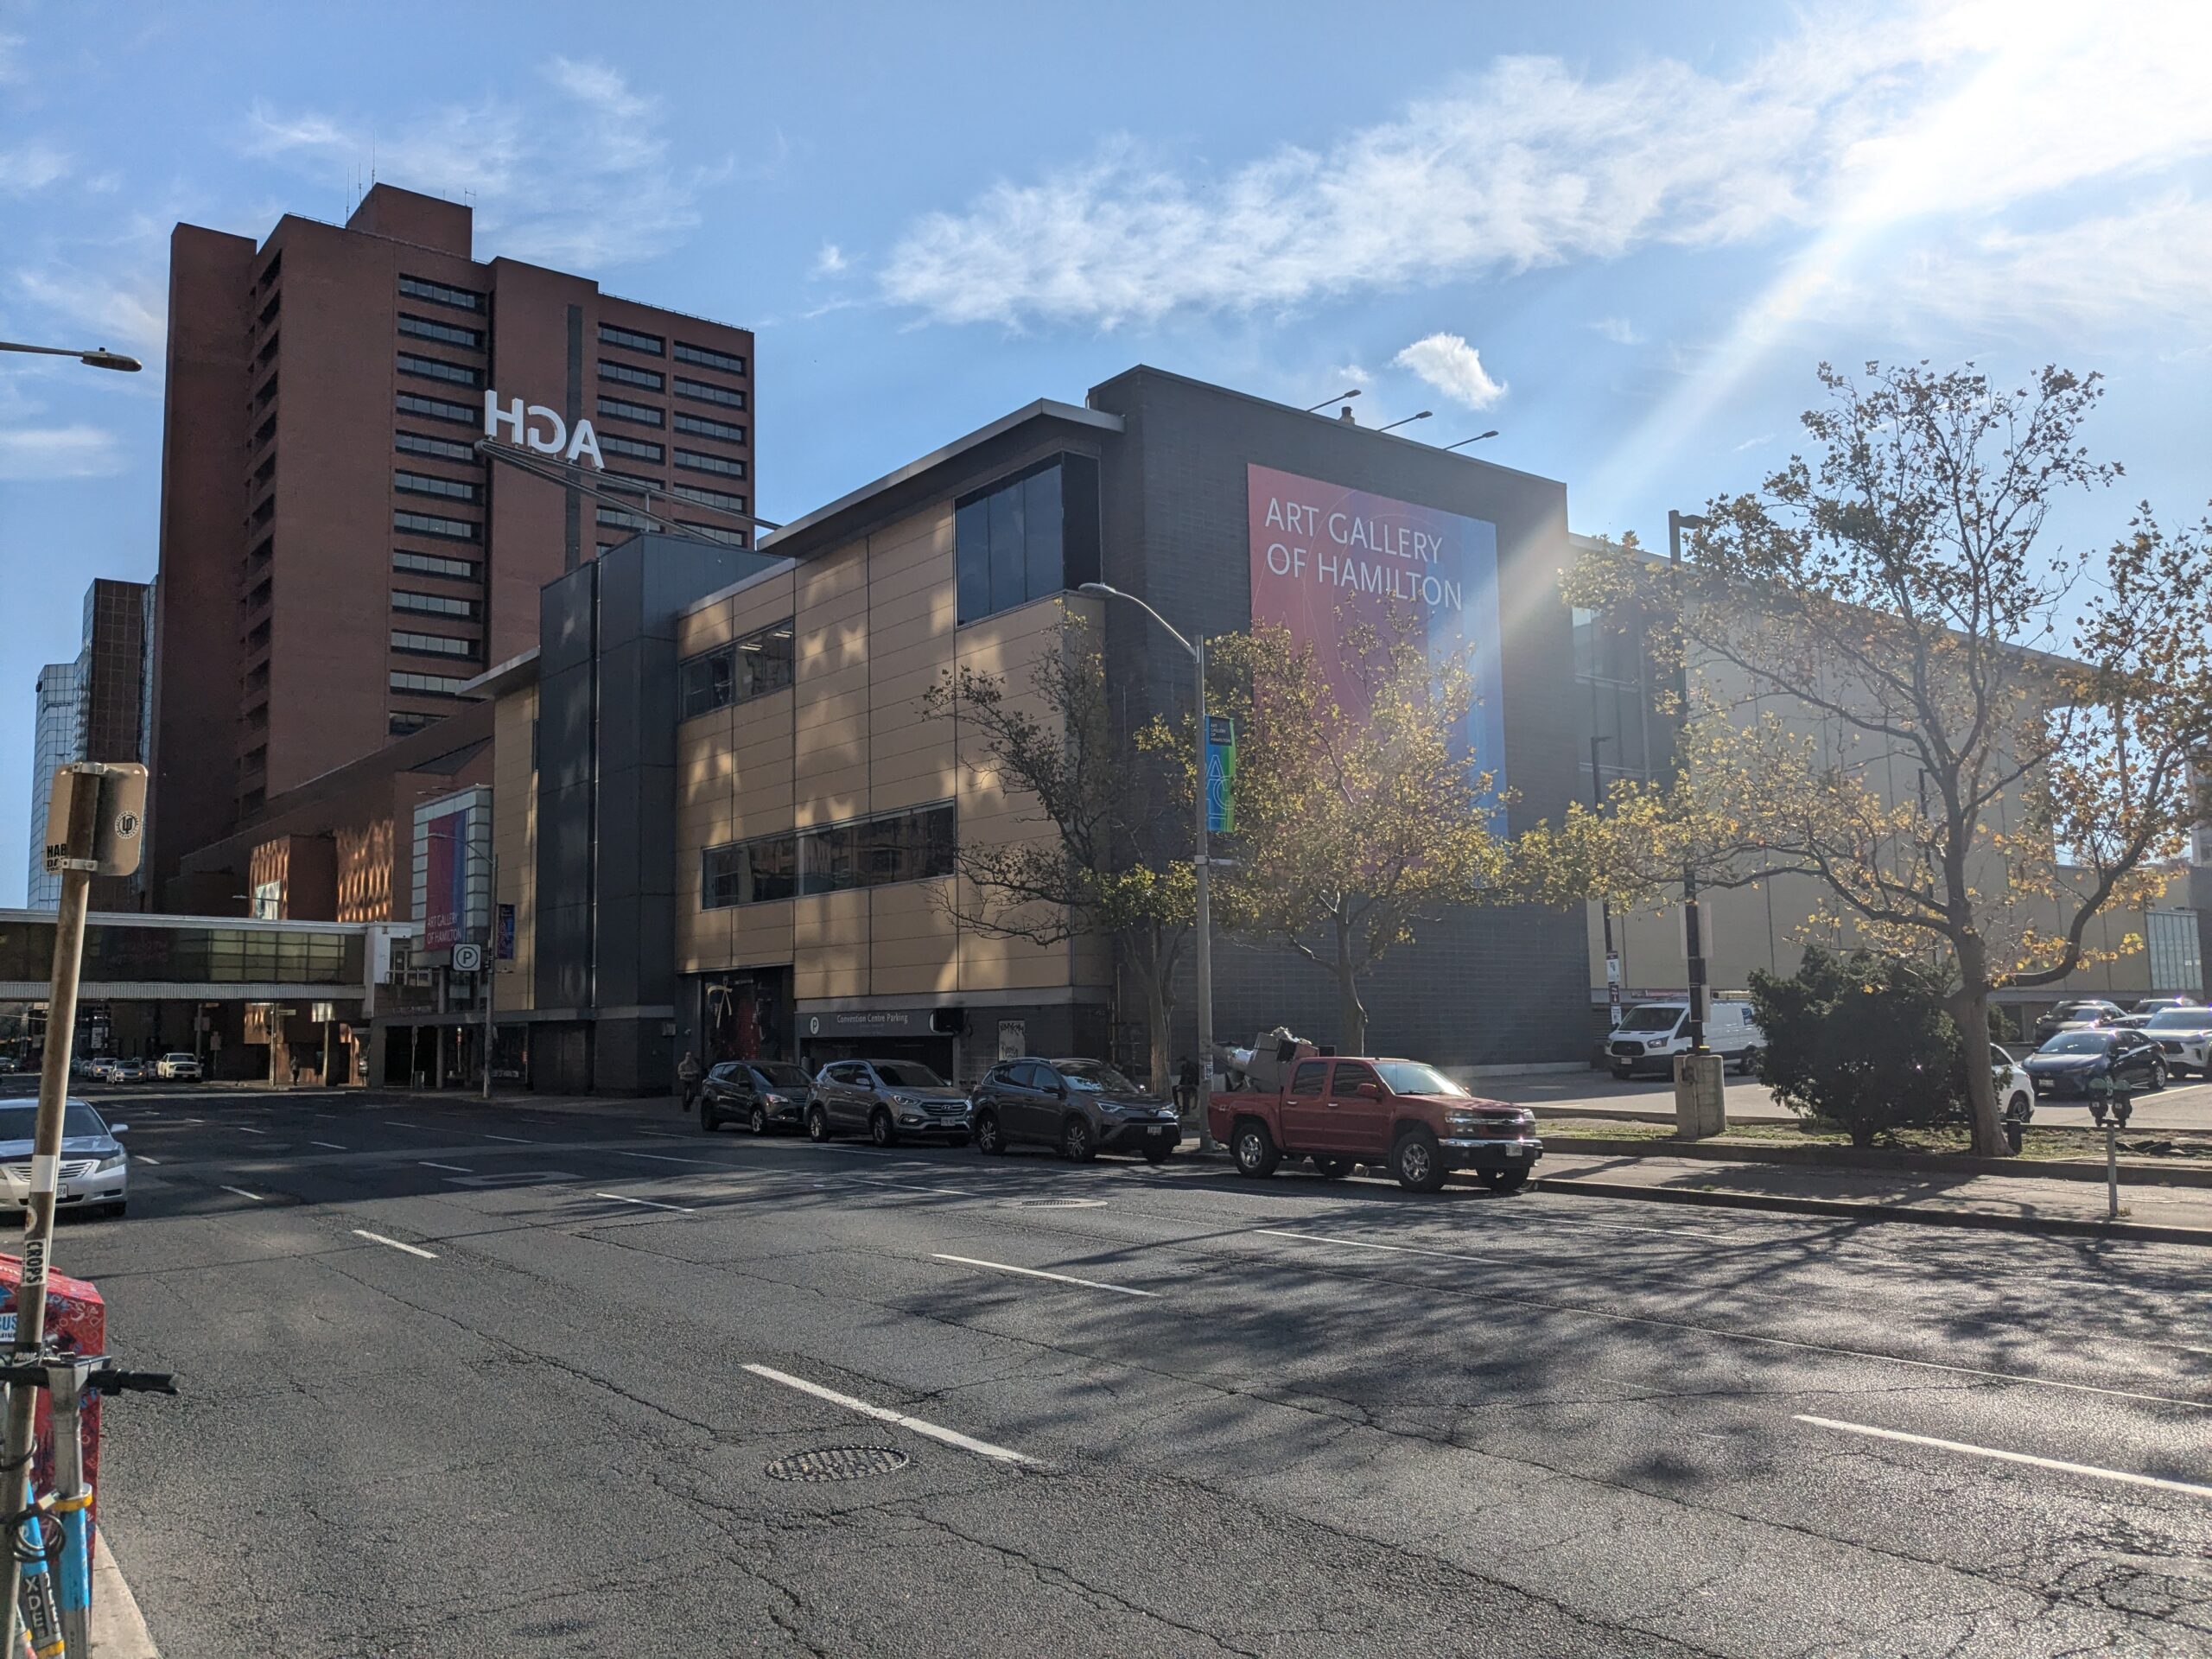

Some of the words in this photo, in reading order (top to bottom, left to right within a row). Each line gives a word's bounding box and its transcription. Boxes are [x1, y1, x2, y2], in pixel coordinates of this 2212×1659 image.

[1266, 497, 1319, 537] ART
[1328, 512, 1444, 565] GALLERY
[1267, 543, 1307, 578] OF
[1319, 554, 1463, 612] HAMILTON
[427, 931, 435, 944] OF
[435, 926, 462, 944] HAMILTON
[428, 915, 437, 928] ART
[437, 912, 458, 927] GALLERY
[836, 1014, 867, 1024] Convention
[868, 1014, 886, 1023] Centre
[887, 1012, 908, 1025] Parking
[26, 1241, 44, 1286] CROPS
